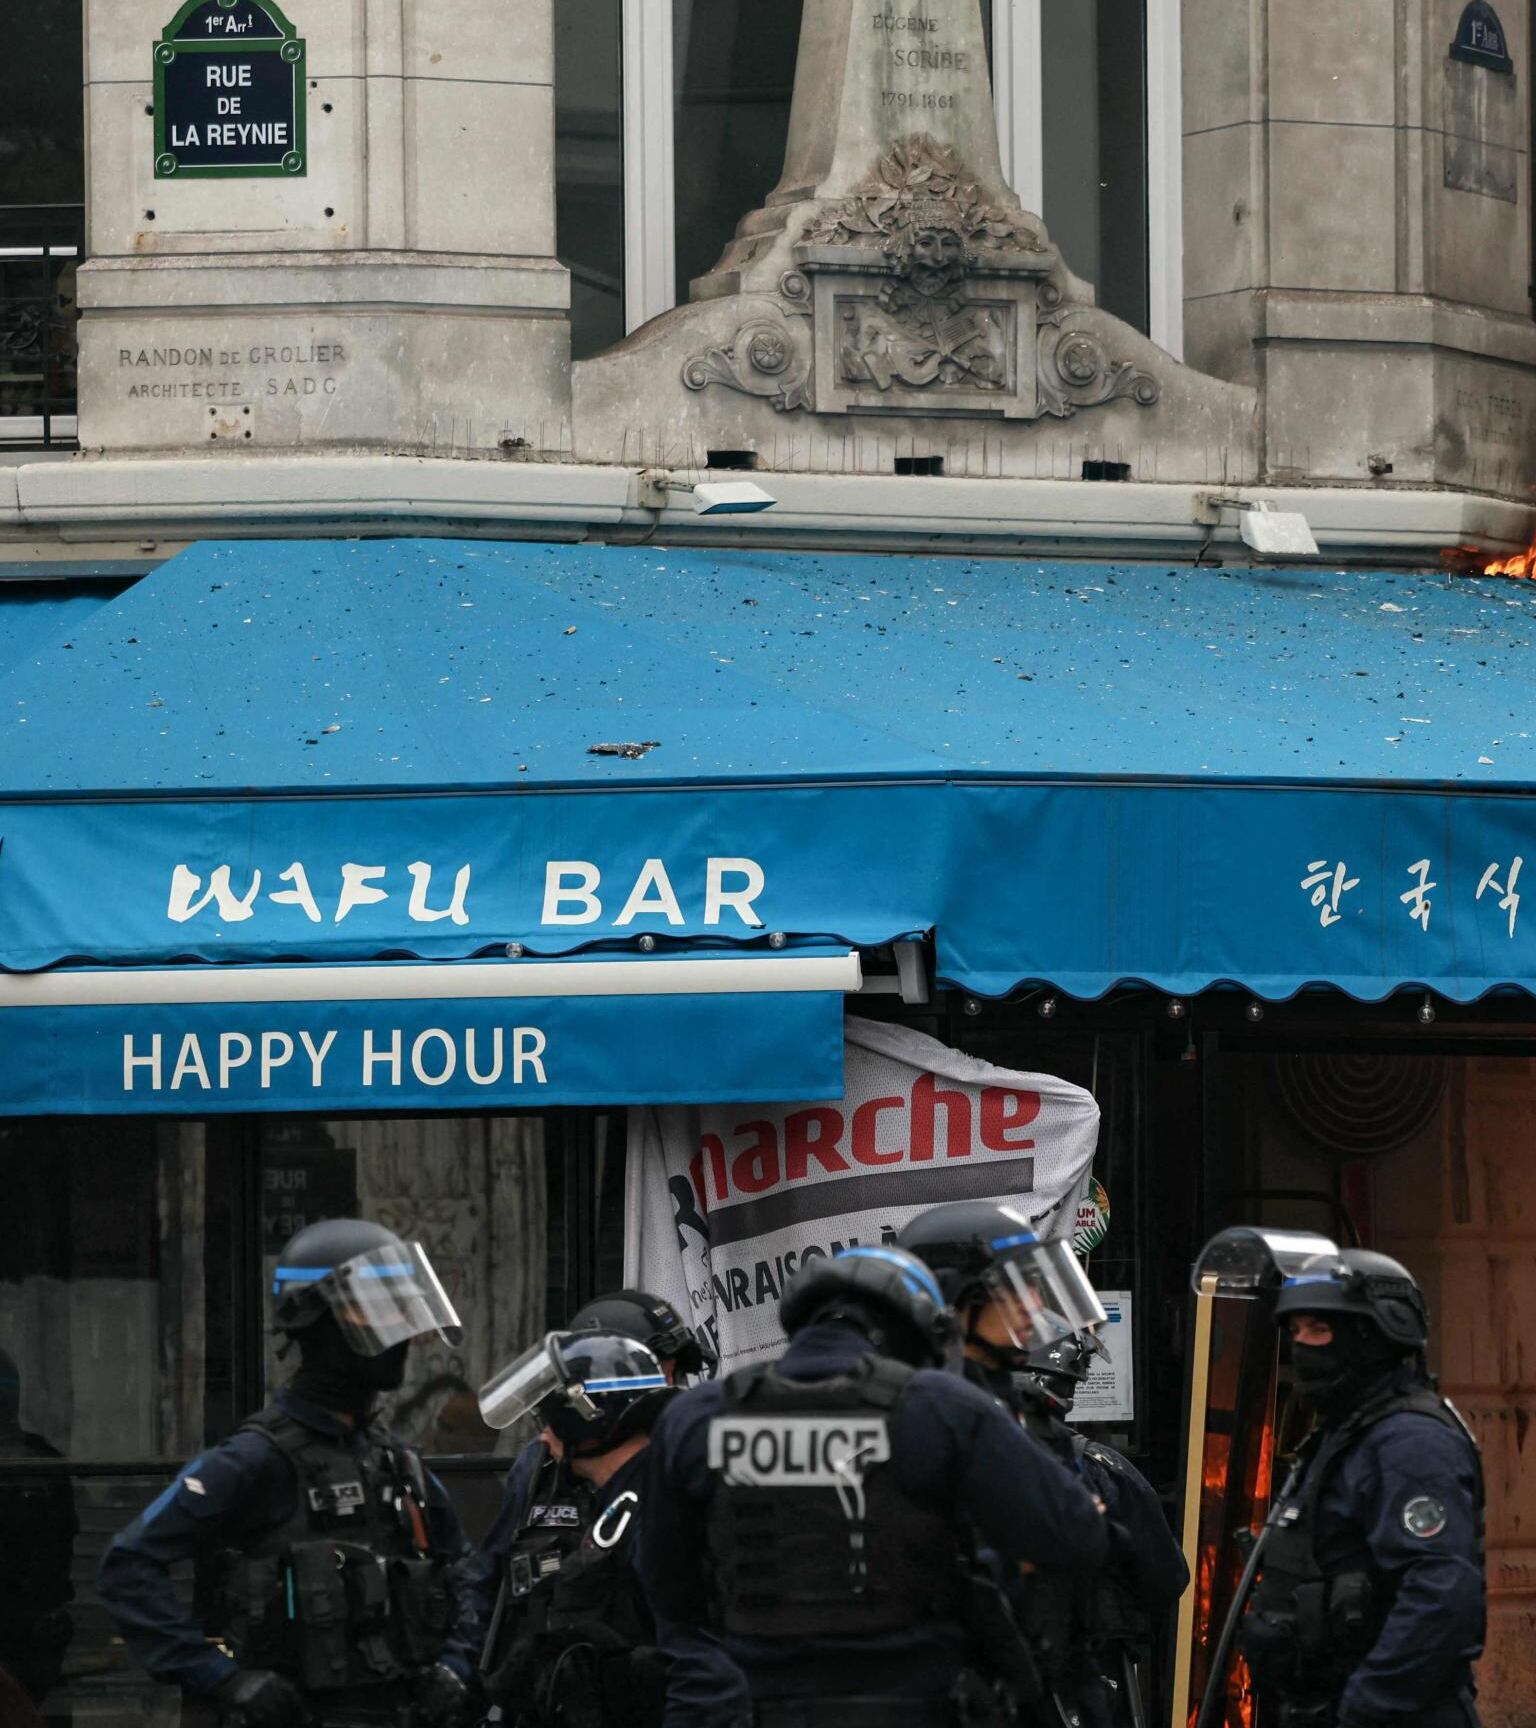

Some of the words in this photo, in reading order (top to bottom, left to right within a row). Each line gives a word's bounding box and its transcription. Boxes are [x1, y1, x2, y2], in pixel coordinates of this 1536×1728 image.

[206, 65, 252, 87] RUE
[217, 97, 241, 115] DE
[172, 124, 200, 146] LA
[207, 122, 288, 145] REYNIE
[119, 348, 214, 368] RANDON
[249, 345, 347, 365] GROLIER
[127, 382, 241, 399] ARCHITECTE
[167, 861, 471, 927] WAFU
[541, 857, 765, 928] BAR
[124, 1030, 338, 1091] HAPPY
[364, 1027, 548, 1087] HOUR
[722, 1428, 879, 1476] POLICE
